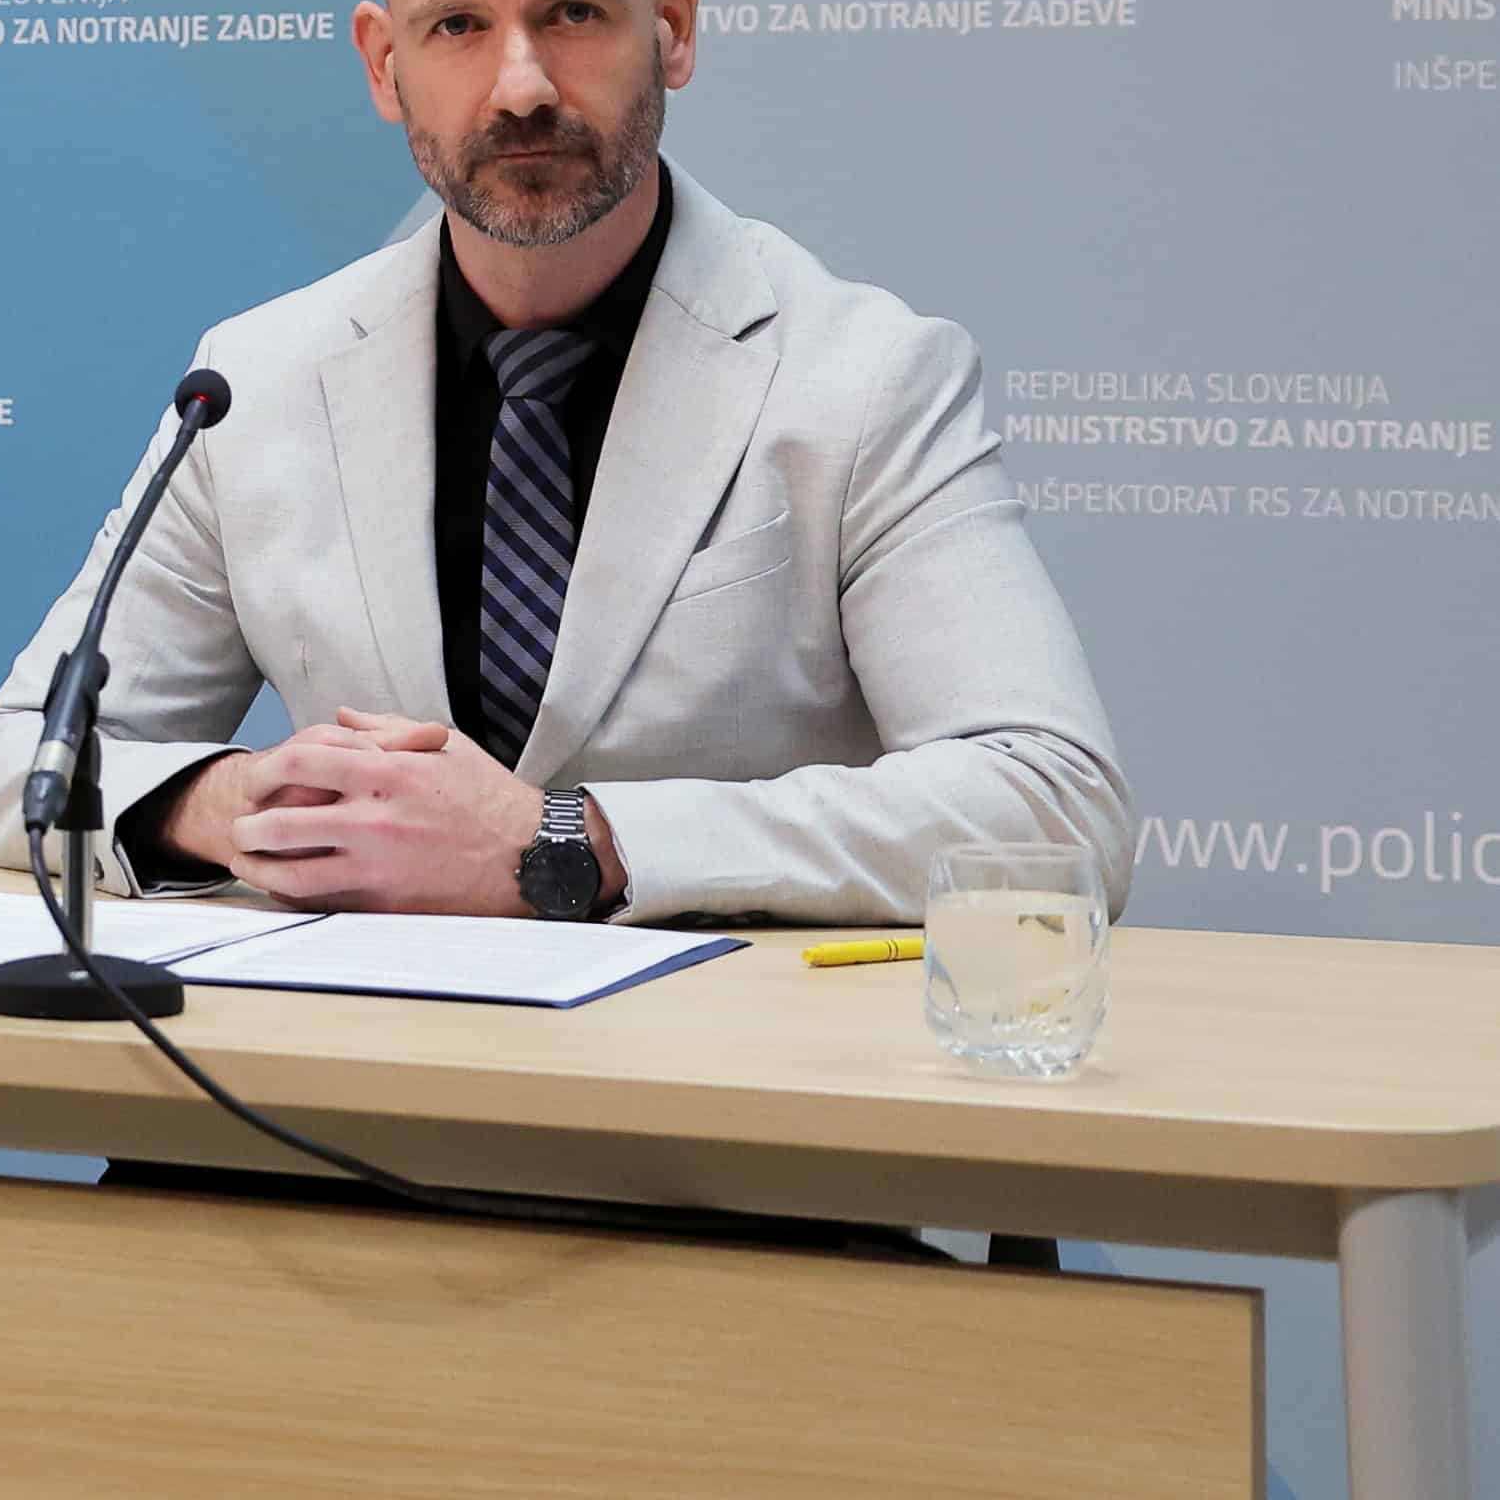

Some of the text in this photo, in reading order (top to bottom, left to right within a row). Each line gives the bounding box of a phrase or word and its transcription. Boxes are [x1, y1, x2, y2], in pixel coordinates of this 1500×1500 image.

[13, 18, 50, 45] ZA
[57, 15, 209, 48] NOTRANJE
[217, 12, 334, 41] ZADEVE
[767, 3, 810, 32] ZA
[819, 0, 993, 34] NOTRANJE
[1006, 370, 1389, 410] REPUBLIKA SLOVENIJA
[1004, 414, 1491, 457] MINISTRSTVO ZA NOTRANJE
[1015, 476, 1500, 522] NŠPEKTORAT RS ZA NOTRAN
[1132, 810, 1500, 894] ww.polic
